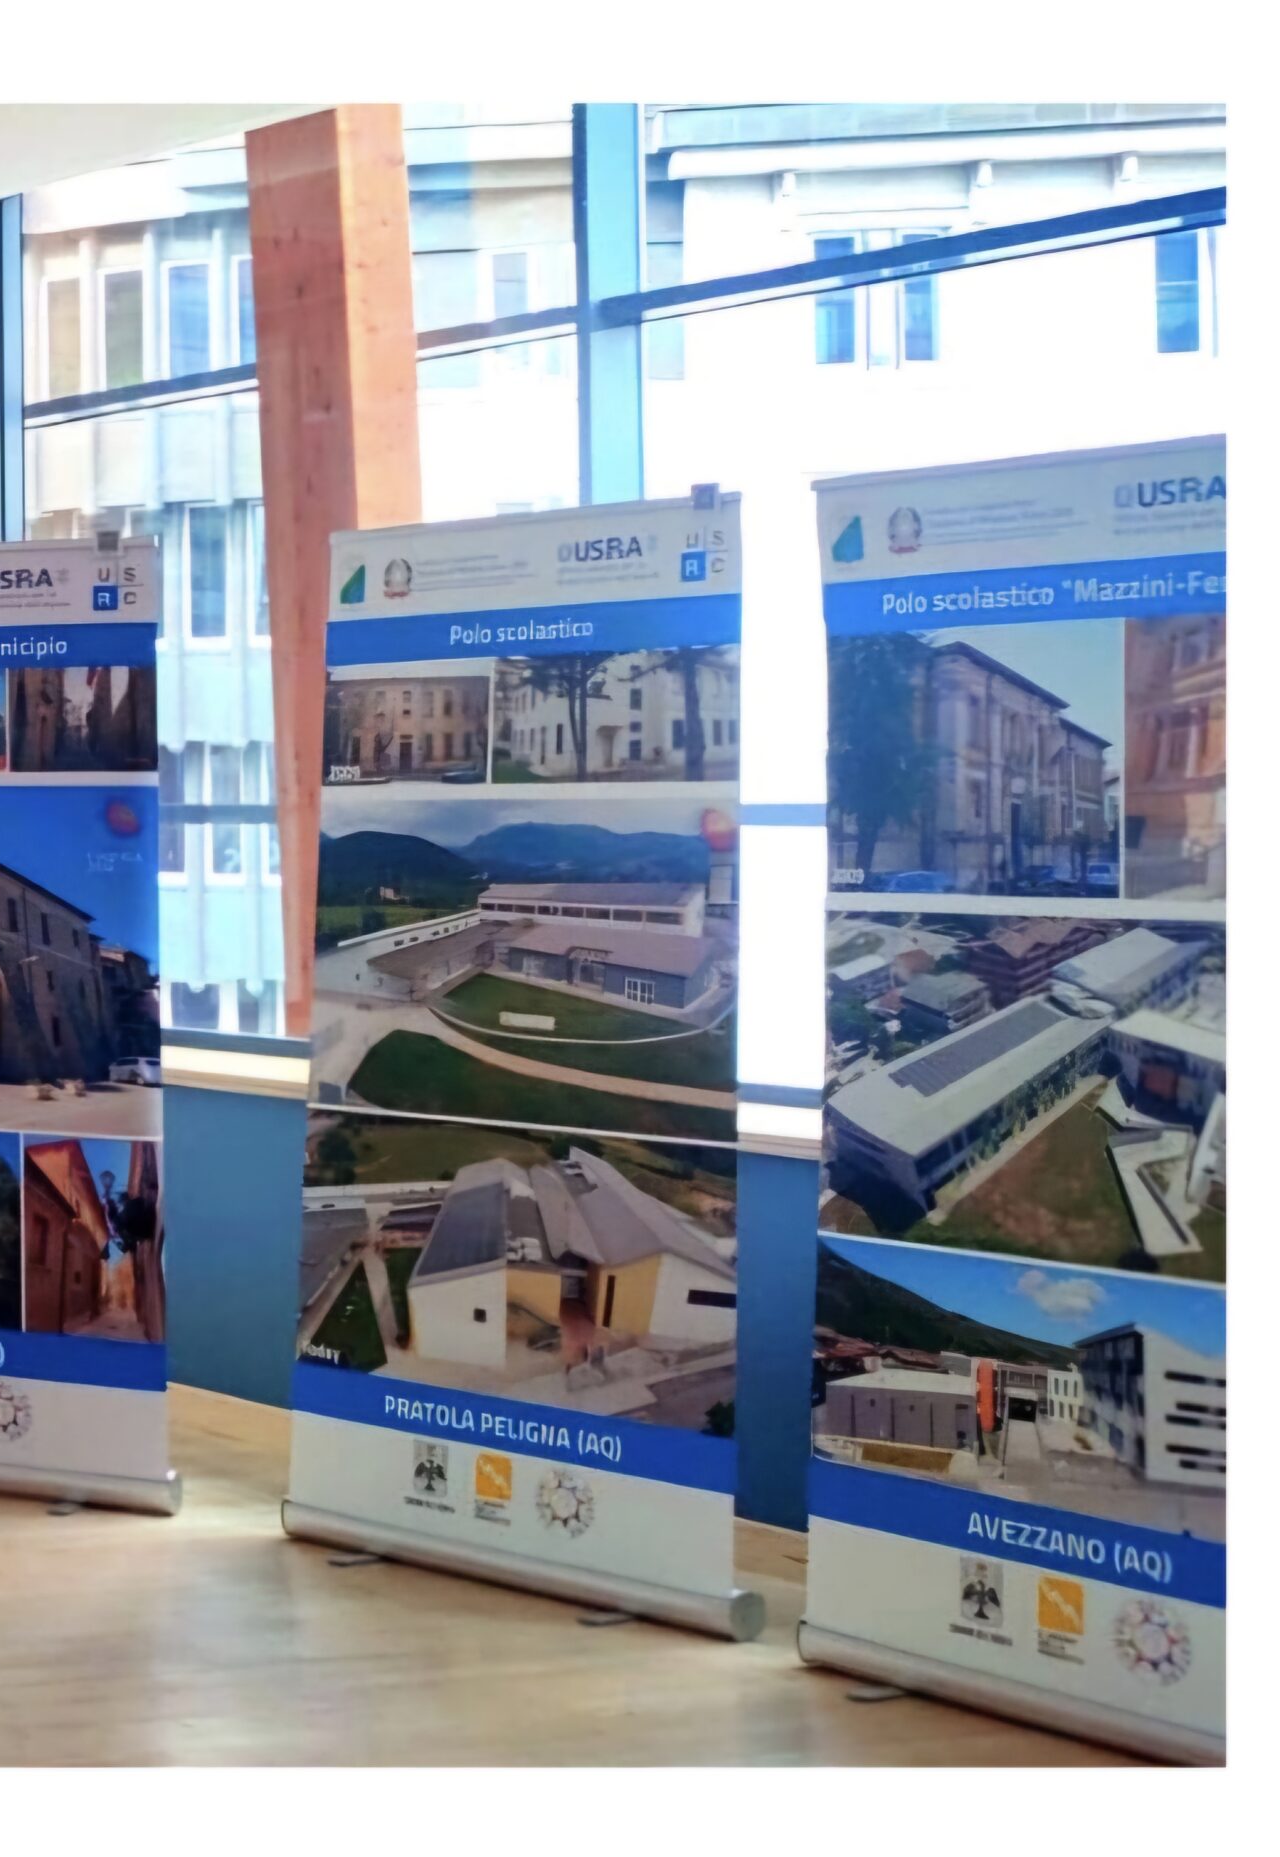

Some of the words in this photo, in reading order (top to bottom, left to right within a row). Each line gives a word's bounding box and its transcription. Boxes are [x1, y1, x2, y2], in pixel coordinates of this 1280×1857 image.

[1137, 476, 1226, 507] USRA
[574, 536, 643, 562] USRA
[883, 590, 928, 616] Polo
[932, 582, 1055, 612] scolastico
[450, 623, 492, 646] Polo
[496, 617, 593, 643] scolastico
[385, 1394, 475, 1432] PRATOLA
[480, 1415, 570, 1450] PELIGNA
[577, 1429, 622, 1463] (AQ)
[966, 1511, 1106, 1565] AVEZZANO
[1114, 1542, 1173, 1585] (AQ)
